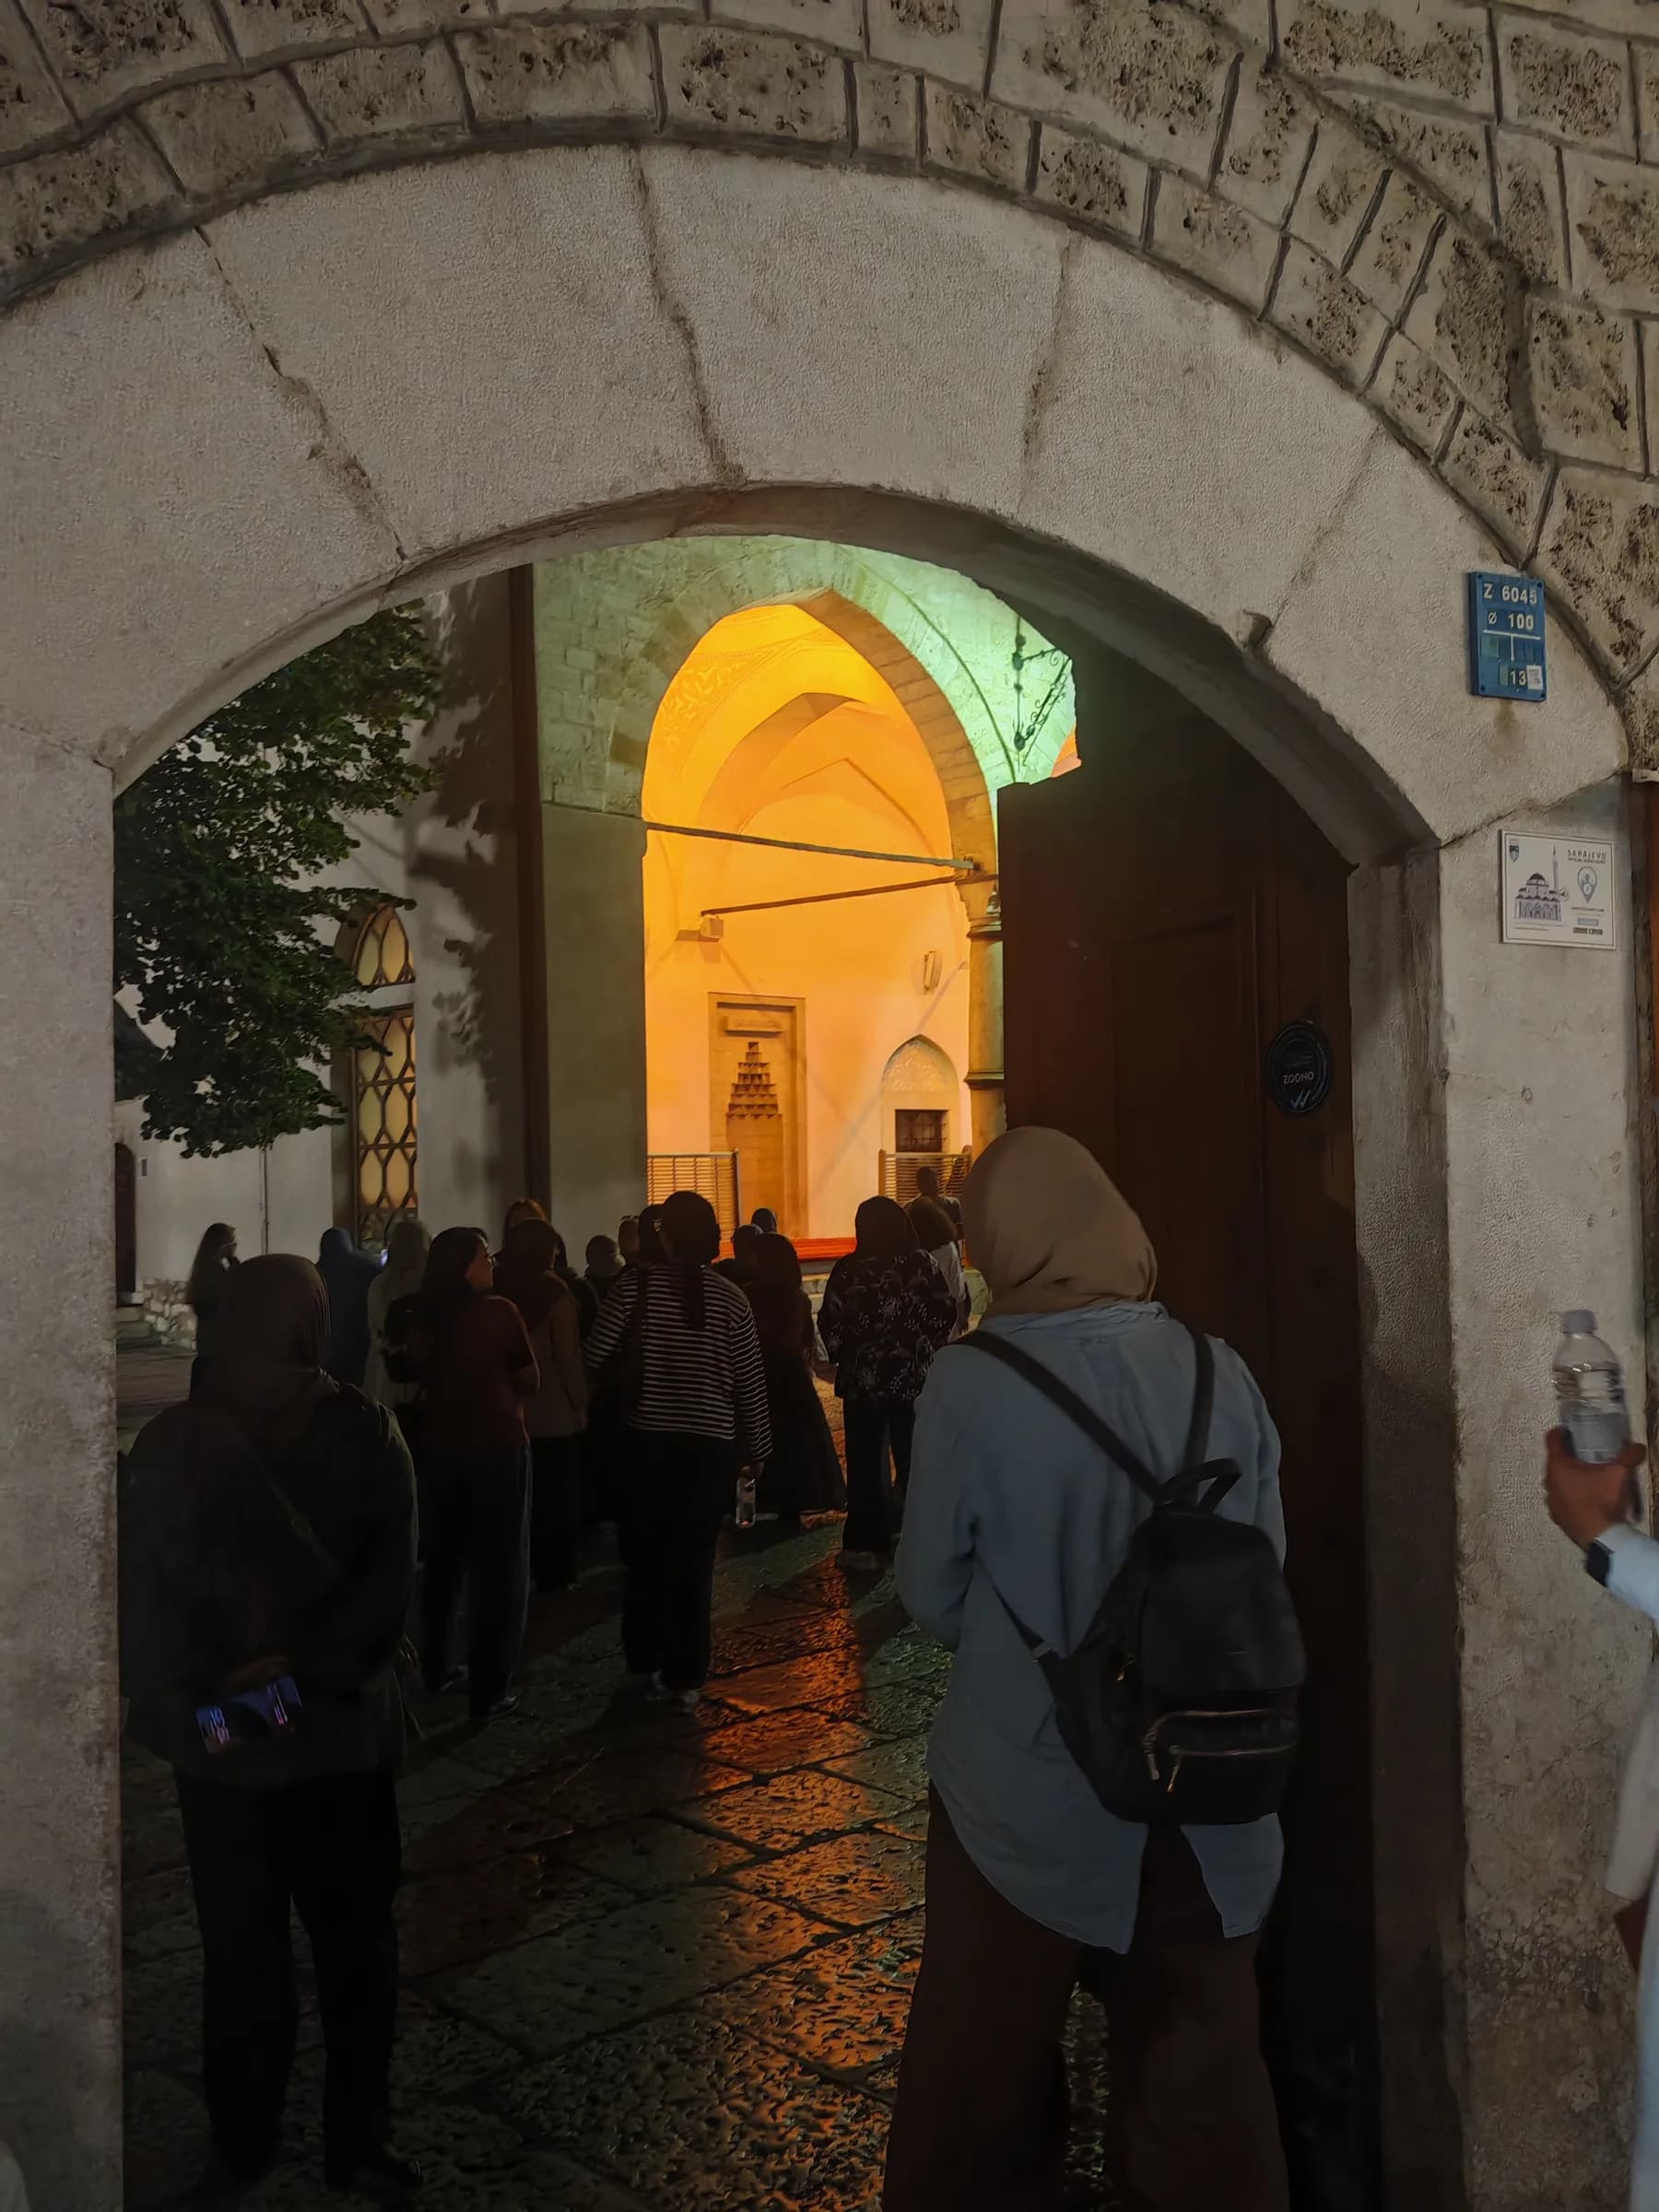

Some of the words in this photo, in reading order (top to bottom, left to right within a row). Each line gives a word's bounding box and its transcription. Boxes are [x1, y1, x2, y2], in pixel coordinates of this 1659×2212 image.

[1483, 583, 1493, 599] Z
[1501, 585, 1537, 605] 6045
[1508, 613, 1535, 630] 100
